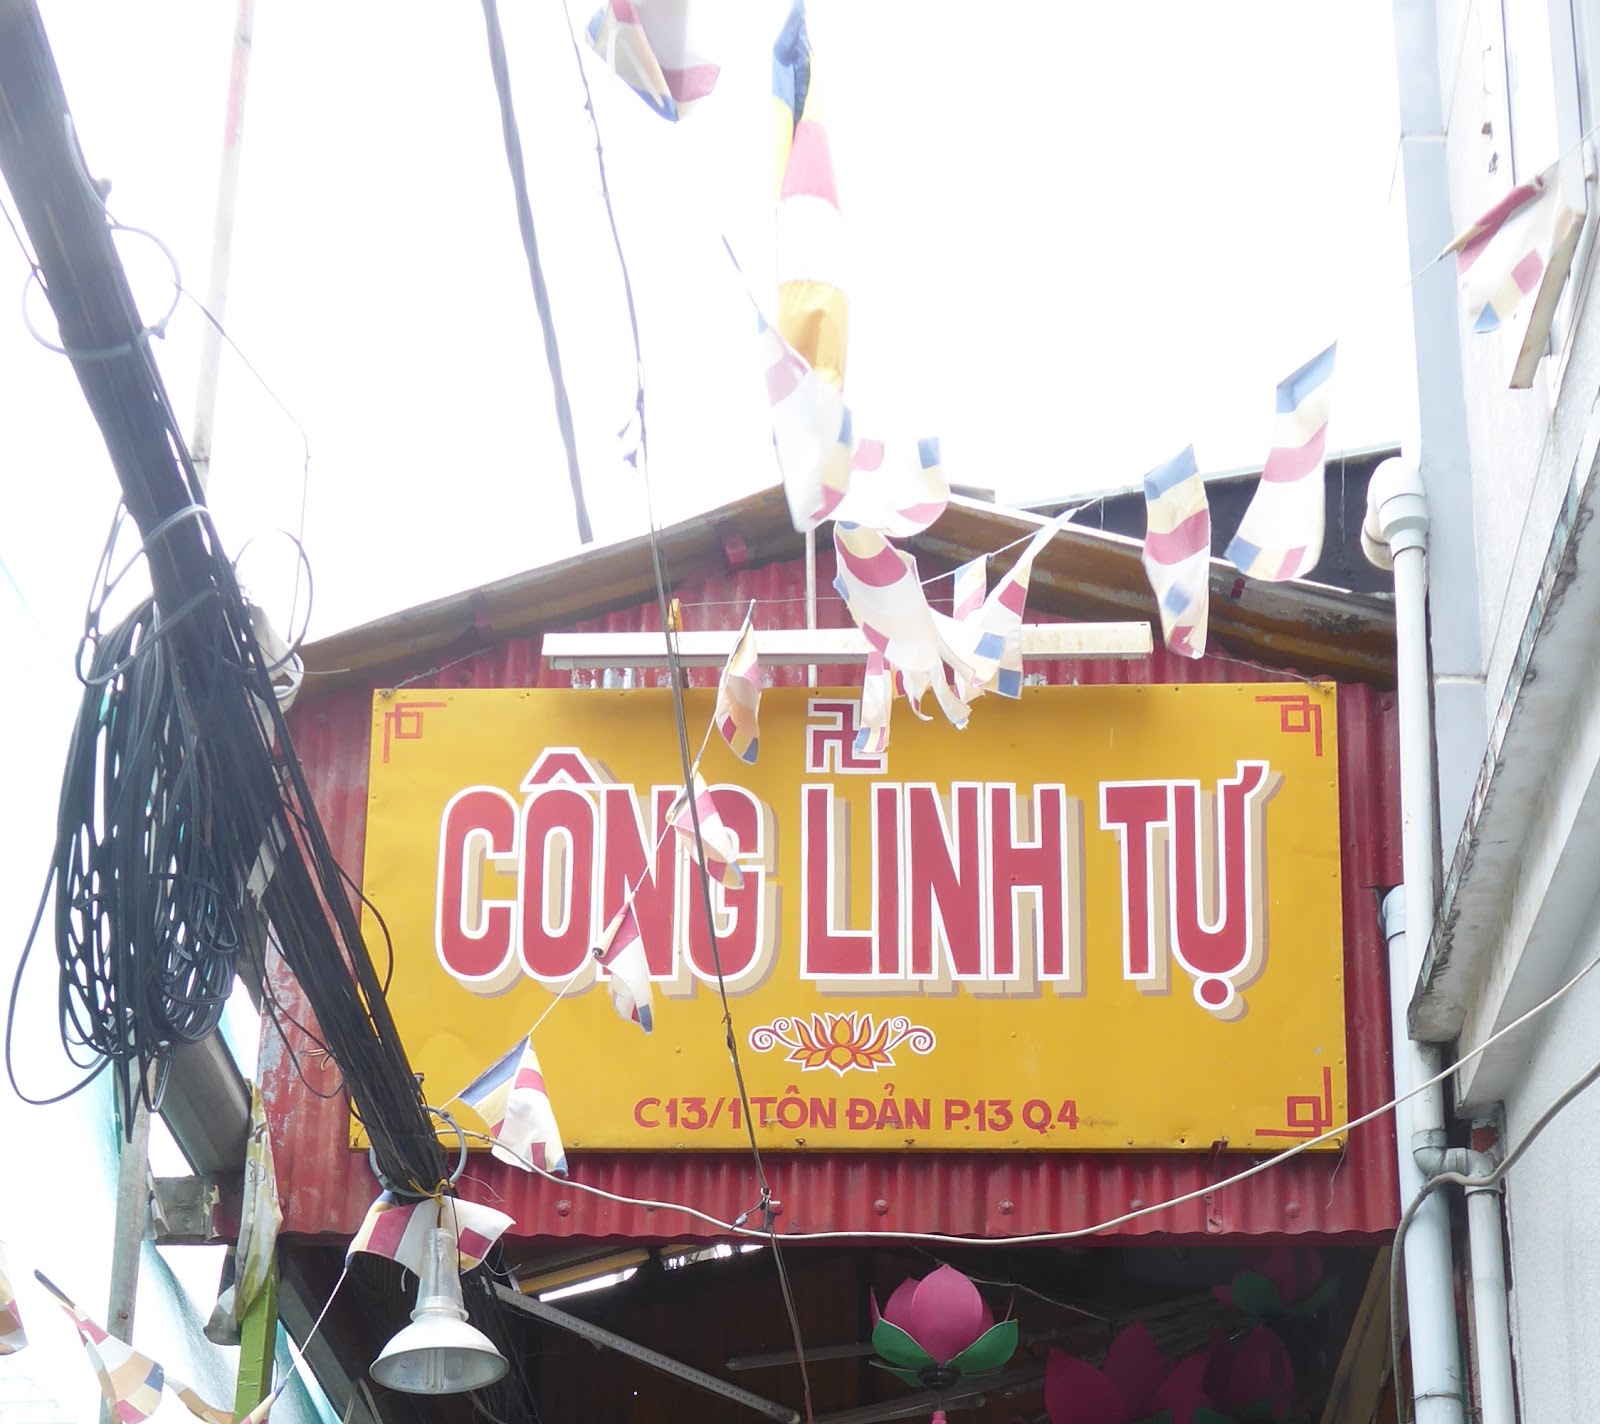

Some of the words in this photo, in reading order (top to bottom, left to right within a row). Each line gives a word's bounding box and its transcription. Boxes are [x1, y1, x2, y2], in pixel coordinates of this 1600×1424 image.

[436, 747, 766, 983] CÔNG
[800, 782, 1068, 981] LINH
[1100, 760, 1270, 1010] TỰ
[749, 1085, 837, 1130] TÔN
[846, 1083, 931, 1130] ĐẢN
[945, 1098, 1014, 1132] P.13
[1022, 1098, 1080, 1135] Q.4
